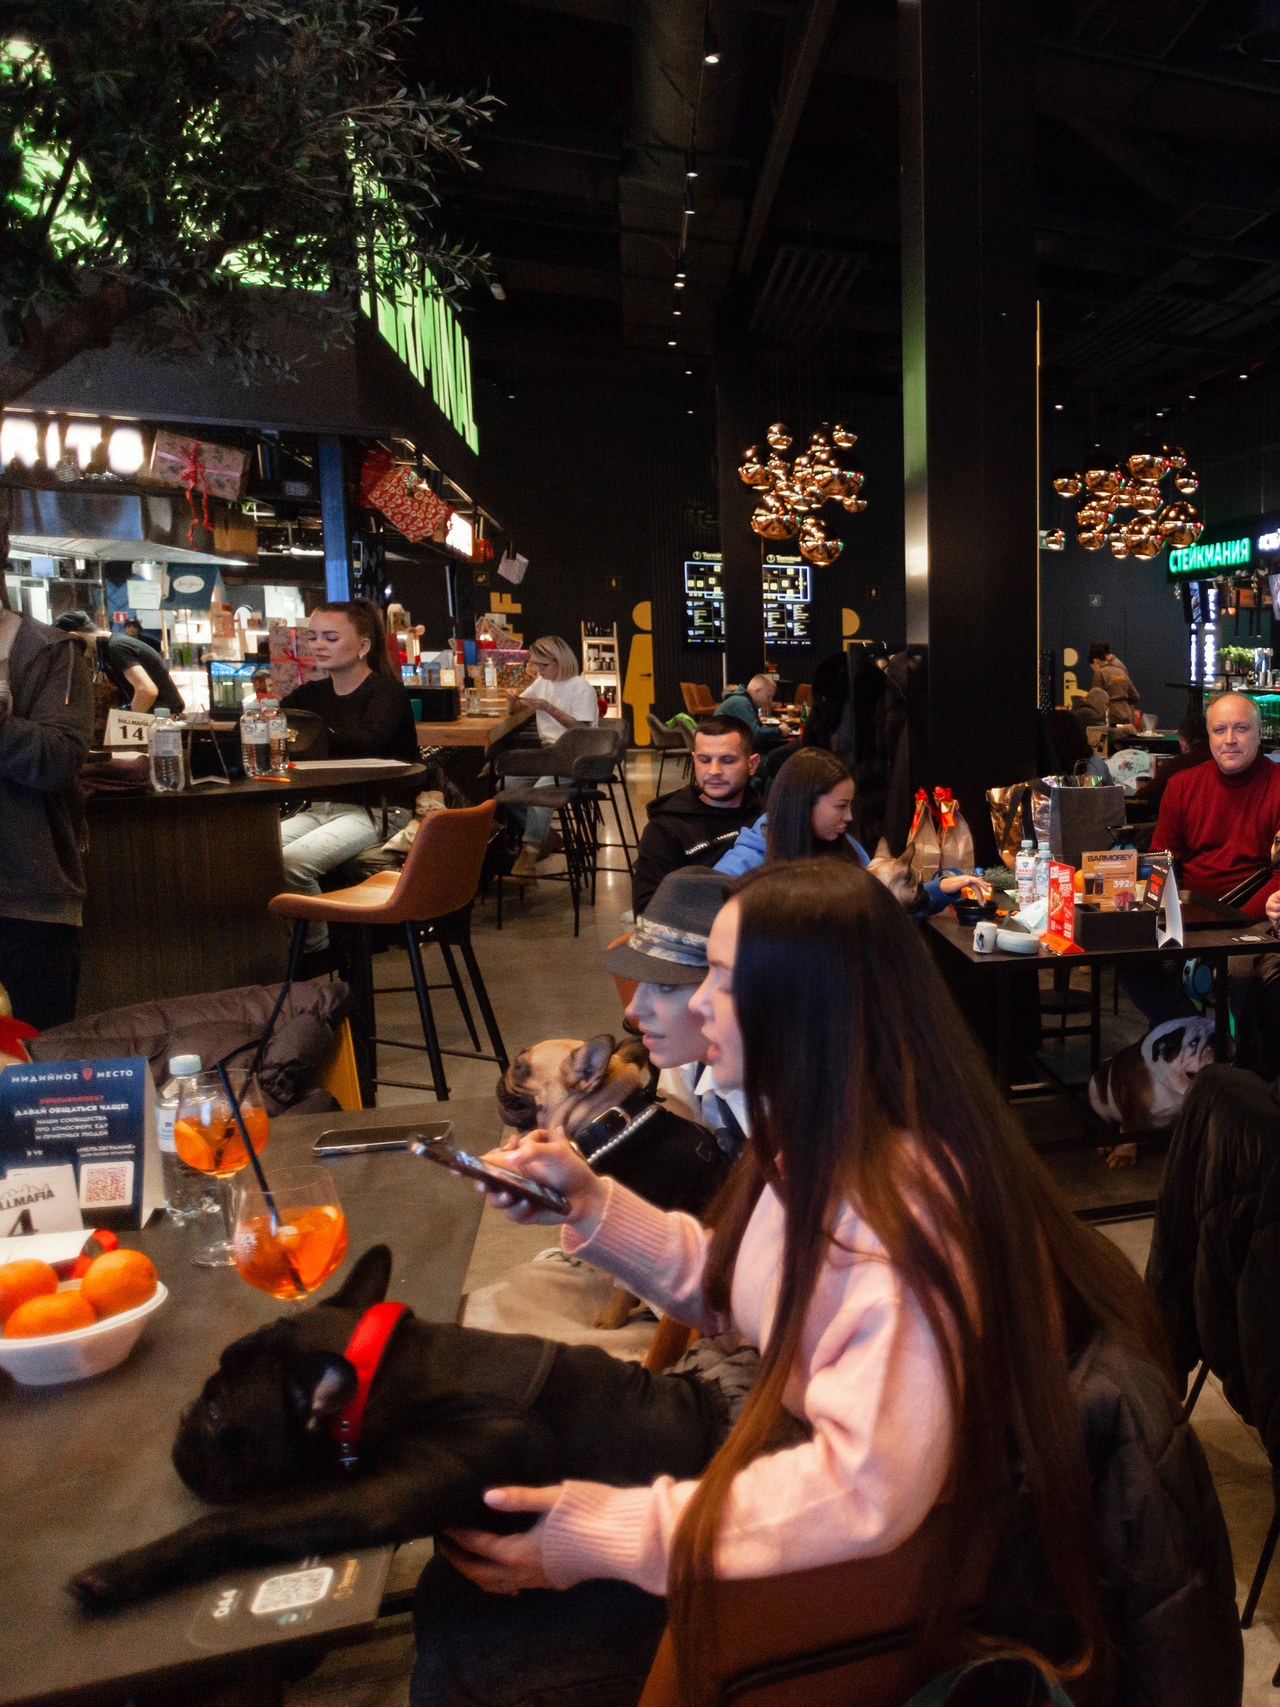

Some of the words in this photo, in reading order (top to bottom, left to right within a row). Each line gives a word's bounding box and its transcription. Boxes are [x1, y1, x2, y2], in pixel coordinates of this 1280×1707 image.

[1169, 537, 1249, 573] СТЕЙКМАНИЯ
[119, 725, 145, 741] 14
[1087, 854, 1133, 862] BARMOREY
[12, 1073, 79, 1084] МИДИЙНОЕ
[96, 1069, 134, 1079] МЕСТО
[15, 1107, 47, 1117] ДАВАЙ
[49, 1105, 97, 1114] ОБЩАТЬСЯ
